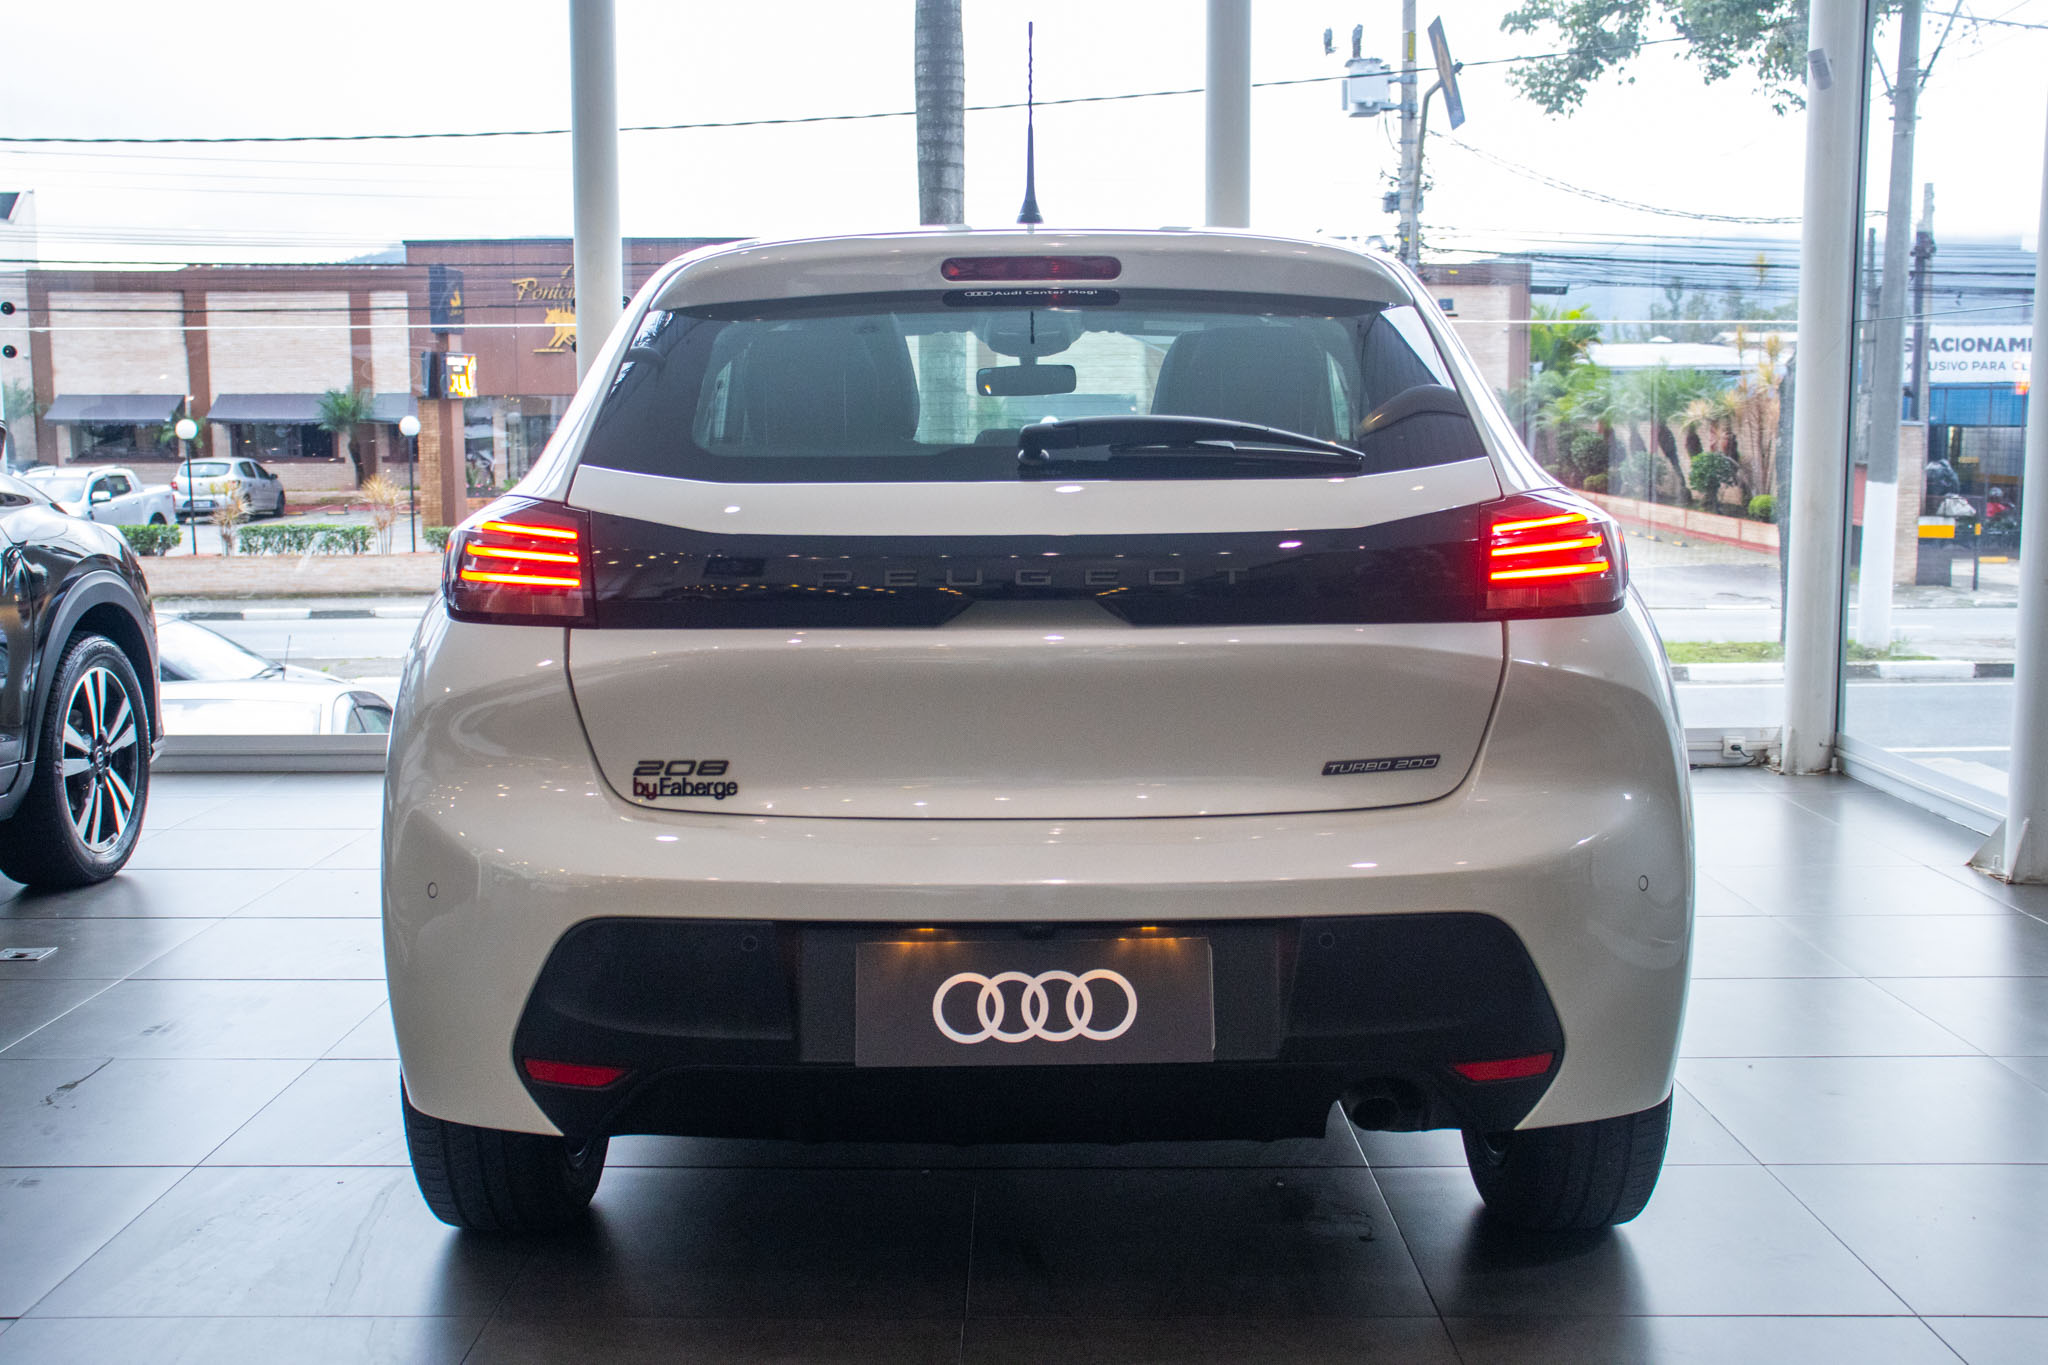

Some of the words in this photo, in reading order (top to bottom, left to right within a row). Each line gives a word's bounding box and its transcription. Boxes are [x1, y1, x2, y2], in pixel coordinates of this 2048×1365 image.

[1972, 361, 2006, 371] PARA
[817, 567, 1248, 588] PEUGEOT
[633, 760, 729, 776] 208
[1328, 761, 1391, 773] TURBO
[1395, 758, 1437, 769] 200
